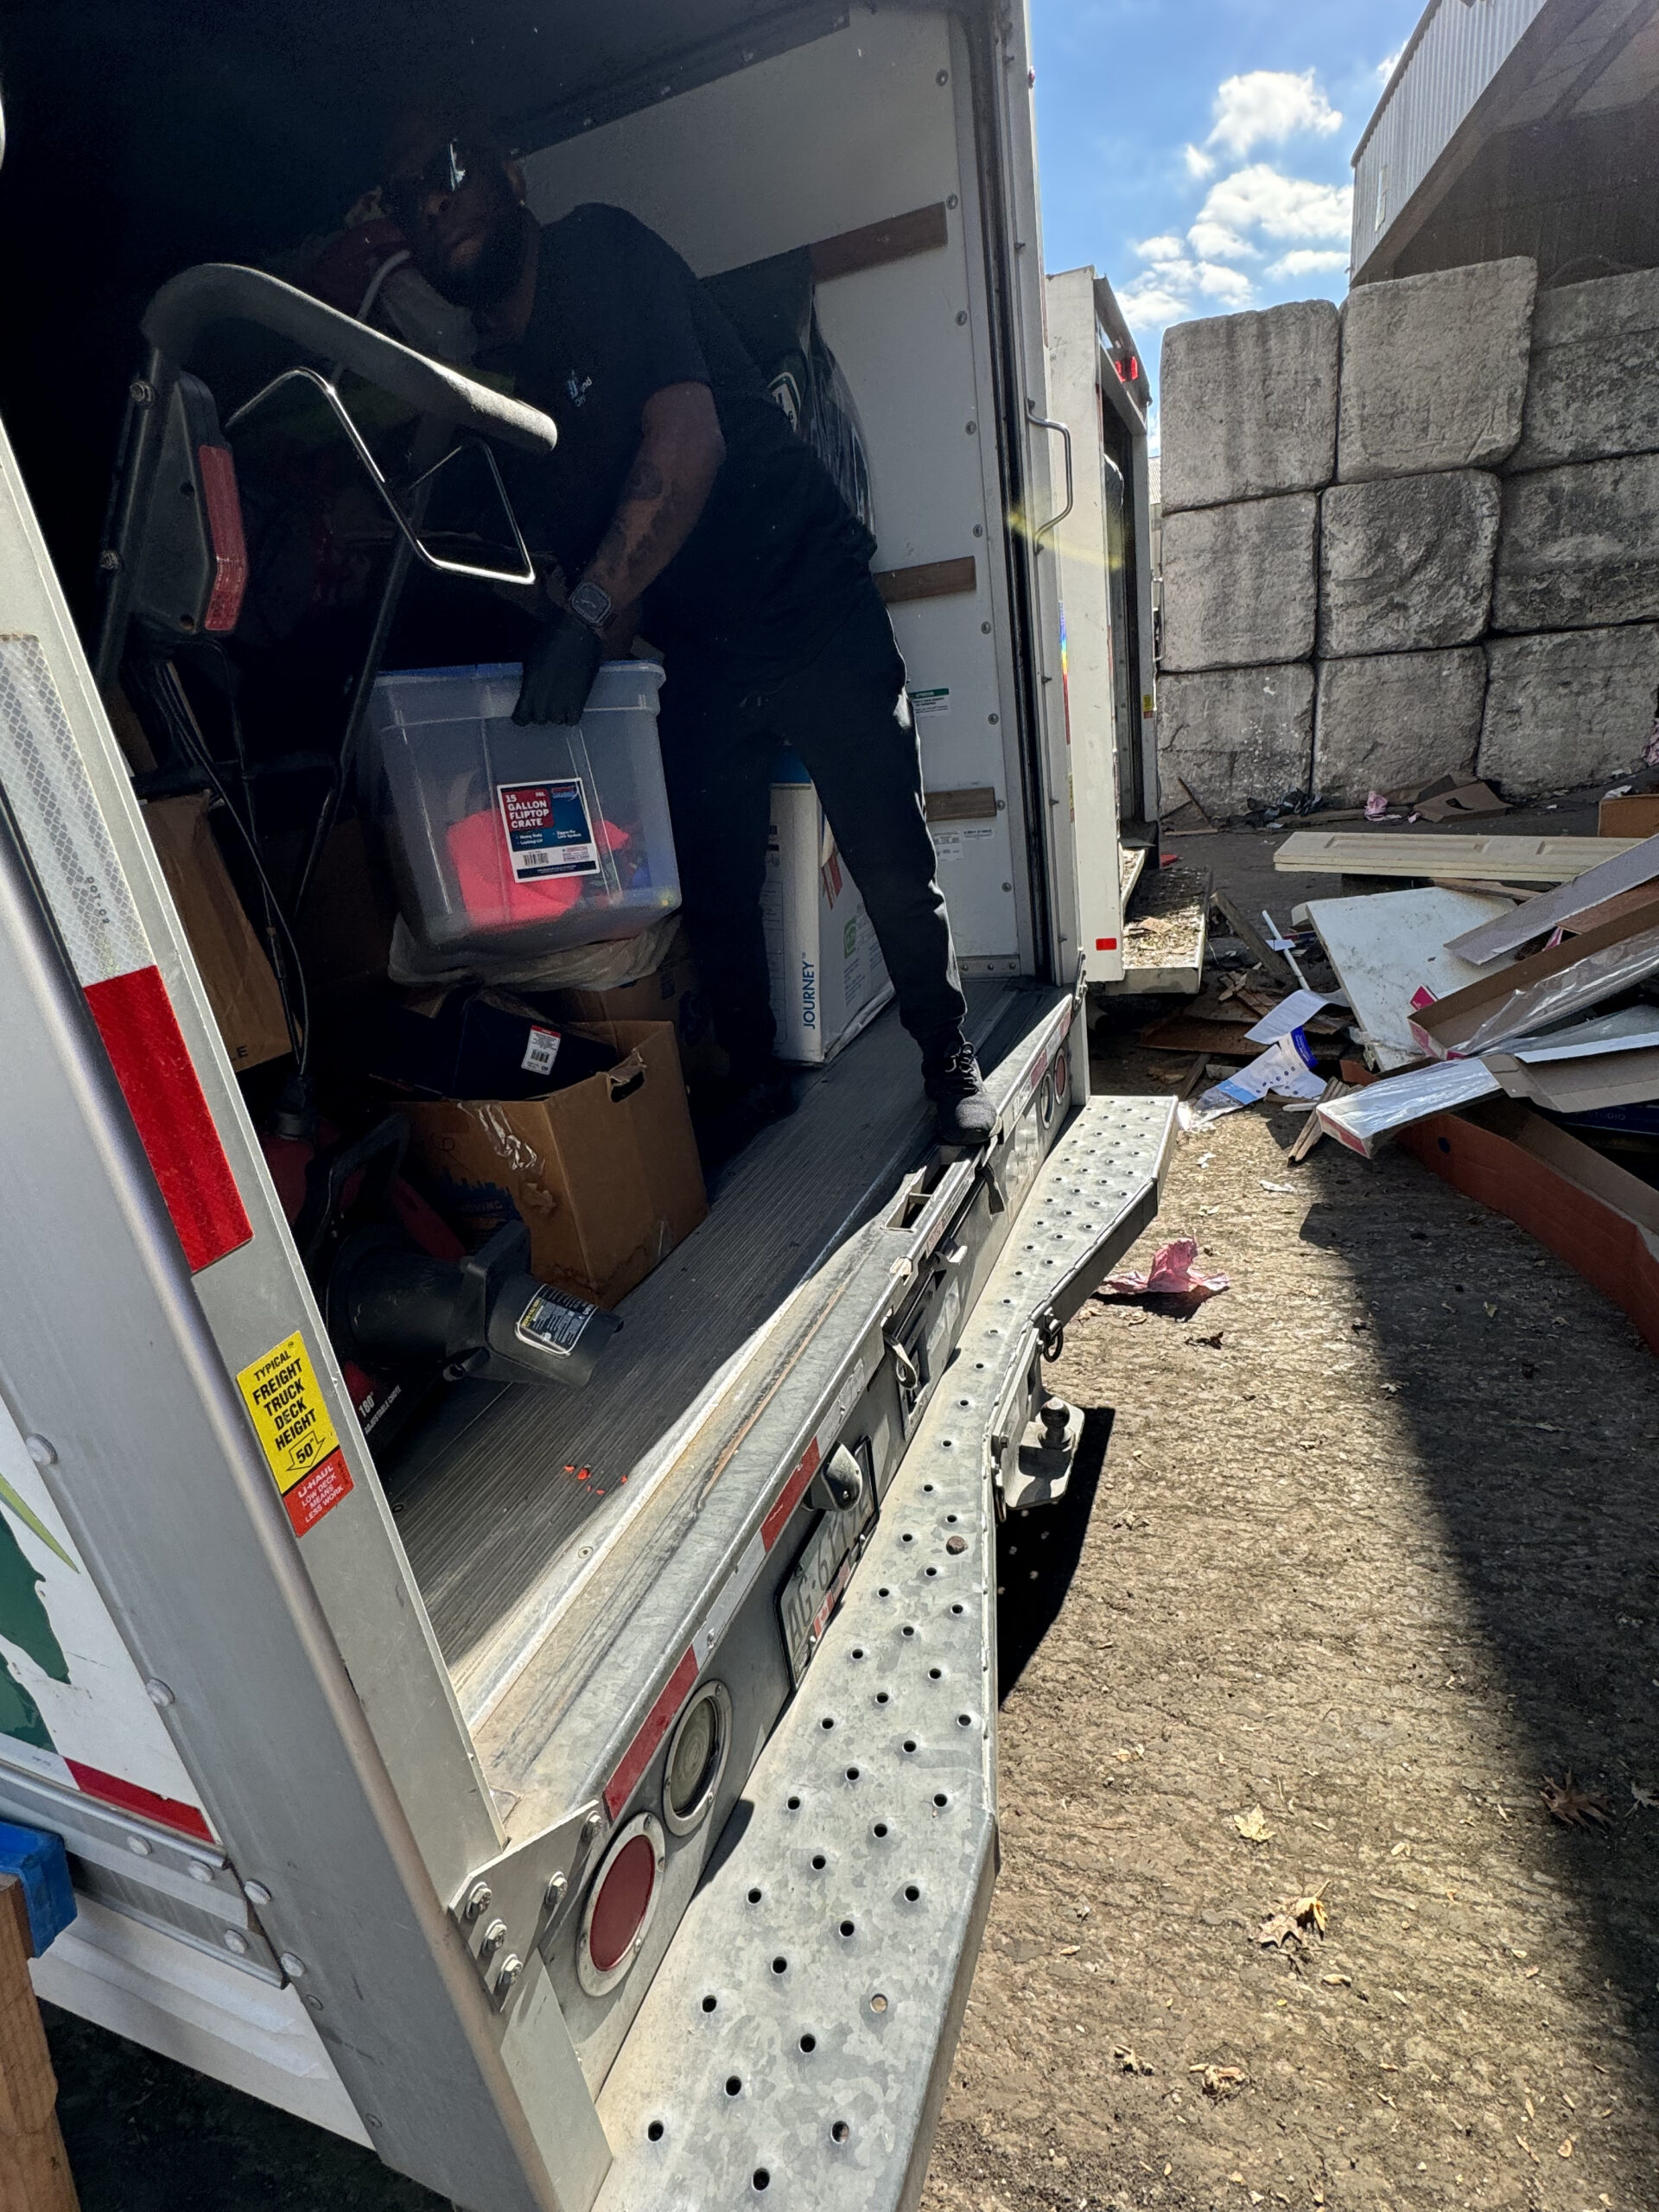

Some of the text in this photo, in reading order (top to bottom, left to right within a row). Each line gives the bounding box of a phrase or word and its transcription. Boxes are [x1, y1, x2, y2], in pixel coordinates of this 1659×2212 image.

[505, 794, 518, 804] 15
[507, 800, 547, 811] GALLON
[509, 809, 550, 821] FLIPTOP
[511, 818, 543, 829] CRATE
[252, 1357, 302, 1406] FREIGHT
[253, 1351, 291, 1382] TYPICAL
[263, 1377, 305, 1417] TRUCK
[274, 1396, 308, 1431] DECK
[275, 1408, 316, 1452] HEIGHT
[296, 1438, 315, 1465] 50"
[297, 1464, 334, 1499] U-HAUL
[301, 1490, 318, 1508] LOW
[317, 1472, 337, 1492] DECK
[309, 1484, 334, 1510] MEANS
[304, 1485, 344, 1523] LESS WORK
